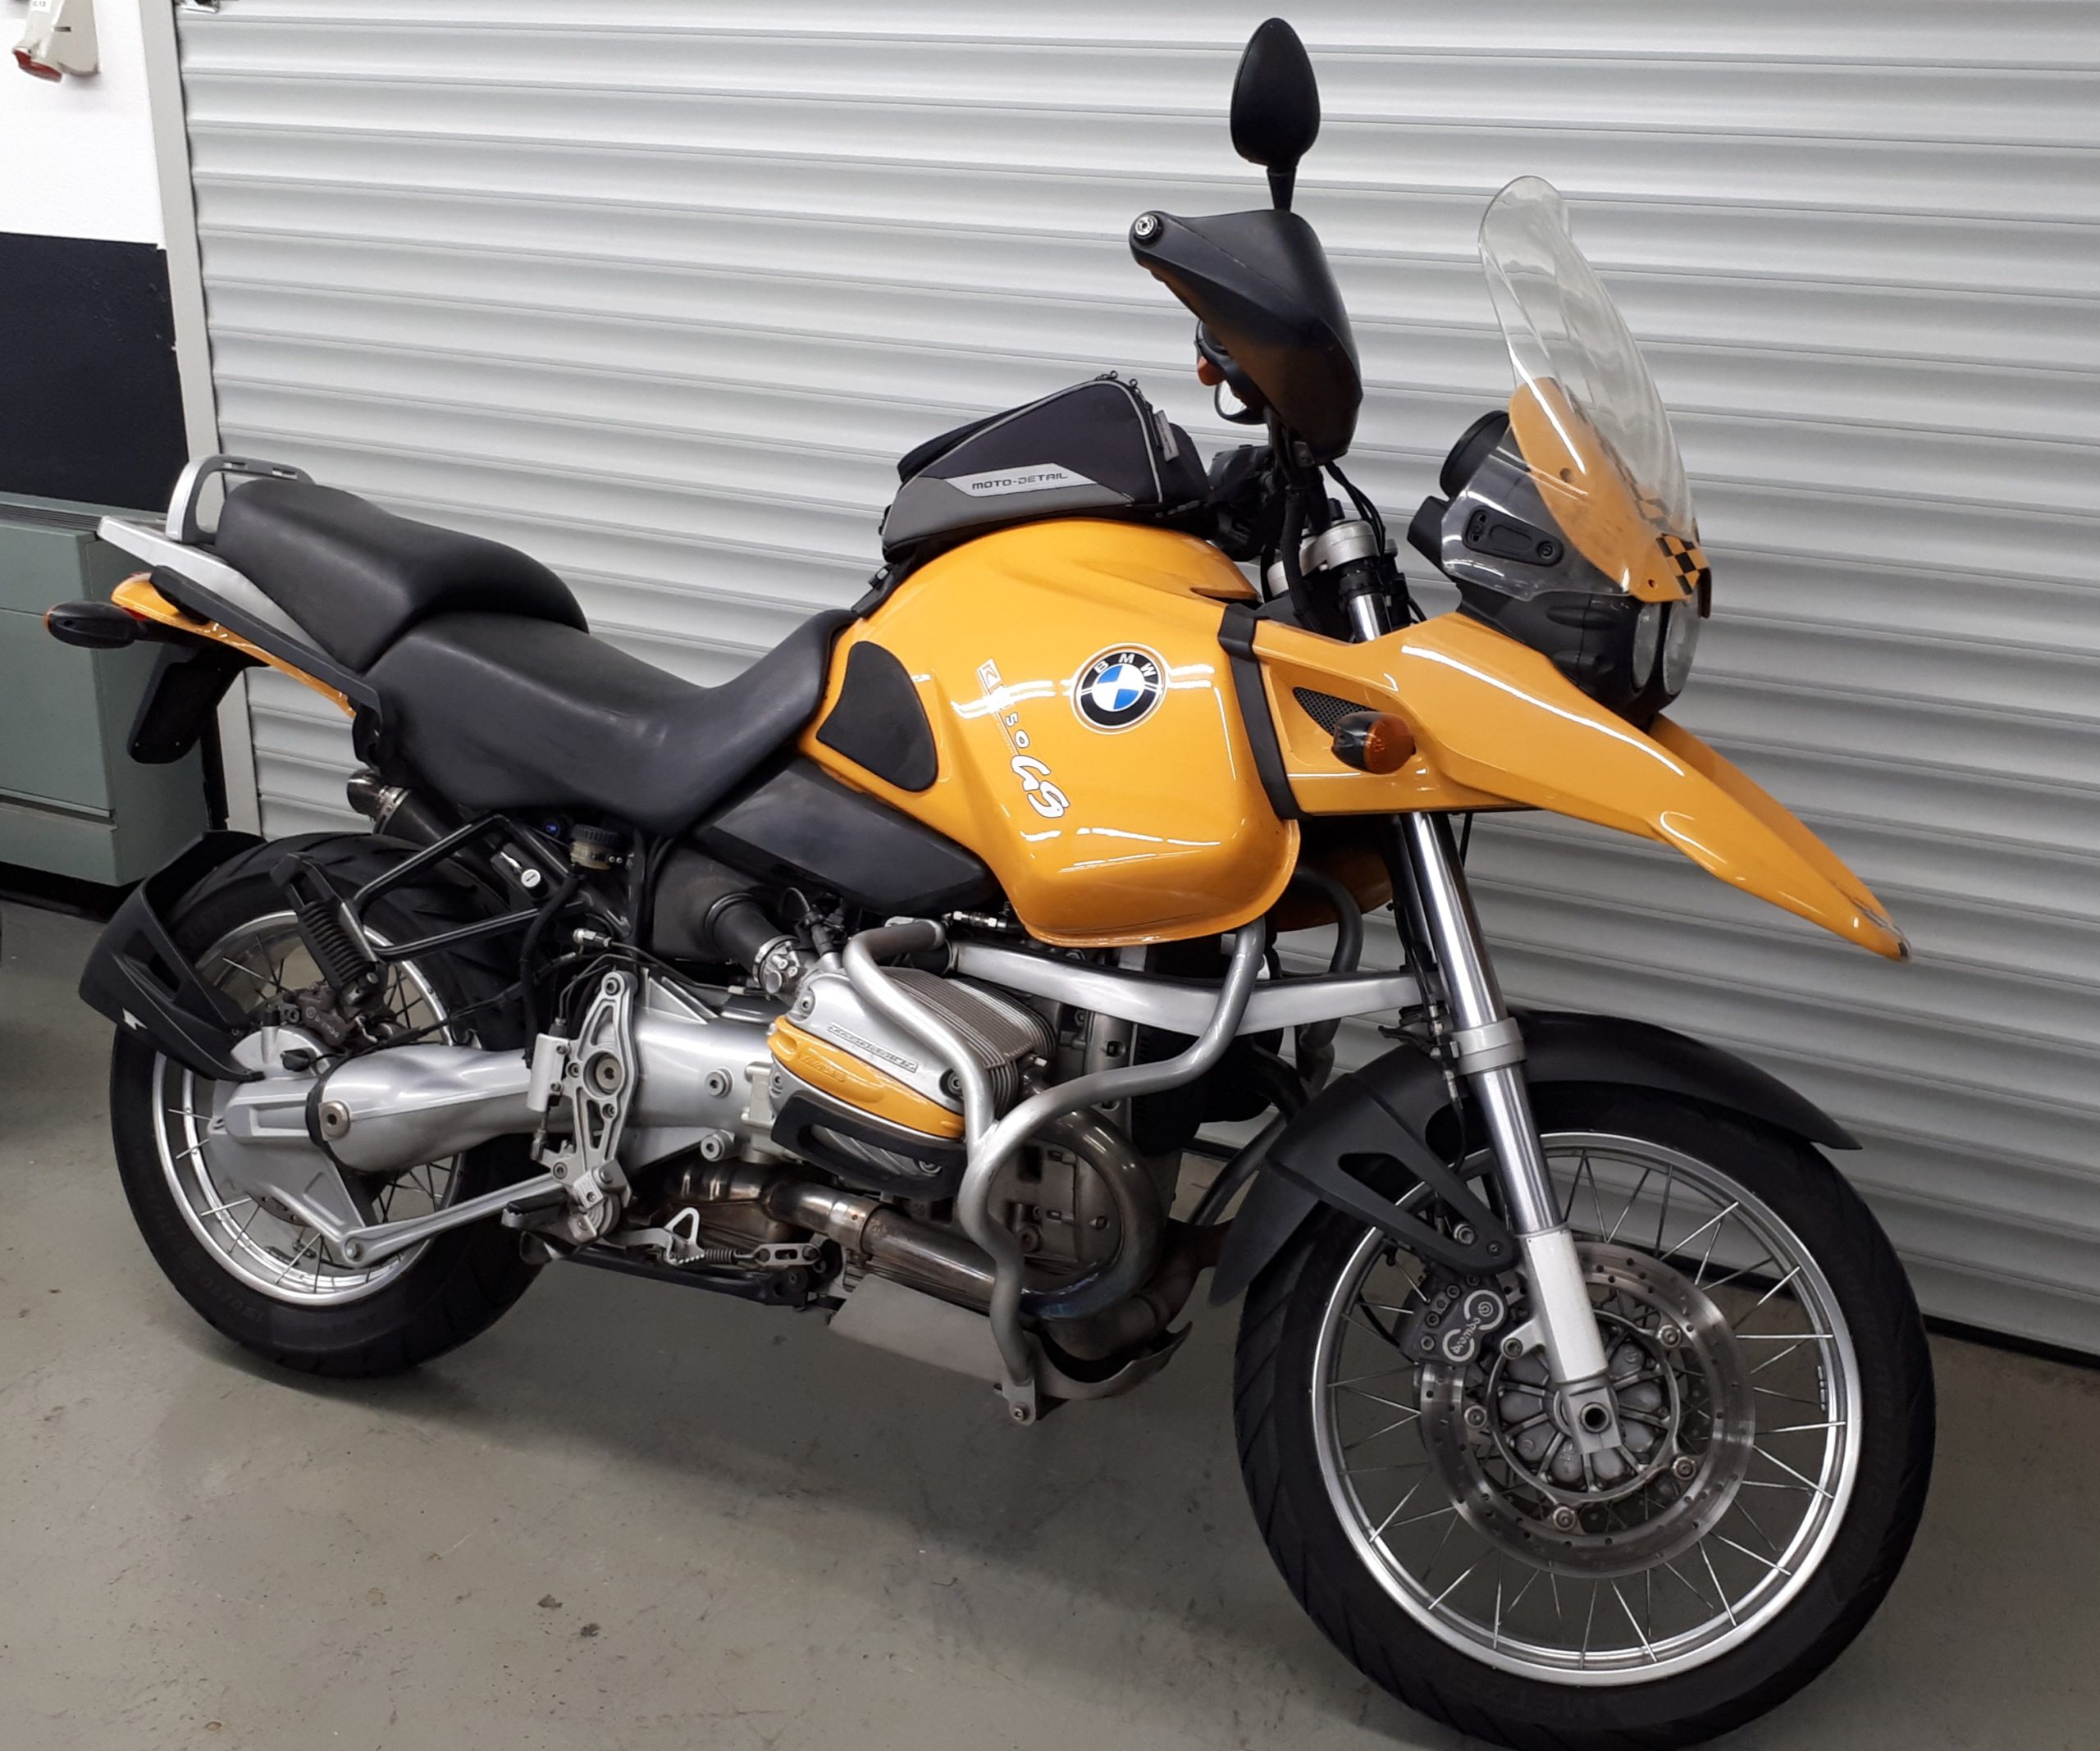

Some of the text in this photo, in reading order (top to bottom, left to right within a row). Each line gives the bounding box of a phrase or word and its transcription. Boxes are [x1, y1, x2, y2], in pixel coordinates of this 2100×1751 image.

[972, 472, 1068, 490] MOTO-DETAIL
[1093, 653, 1157, 677] BMW
[1450, 1317, 1481, 1354] brembo
